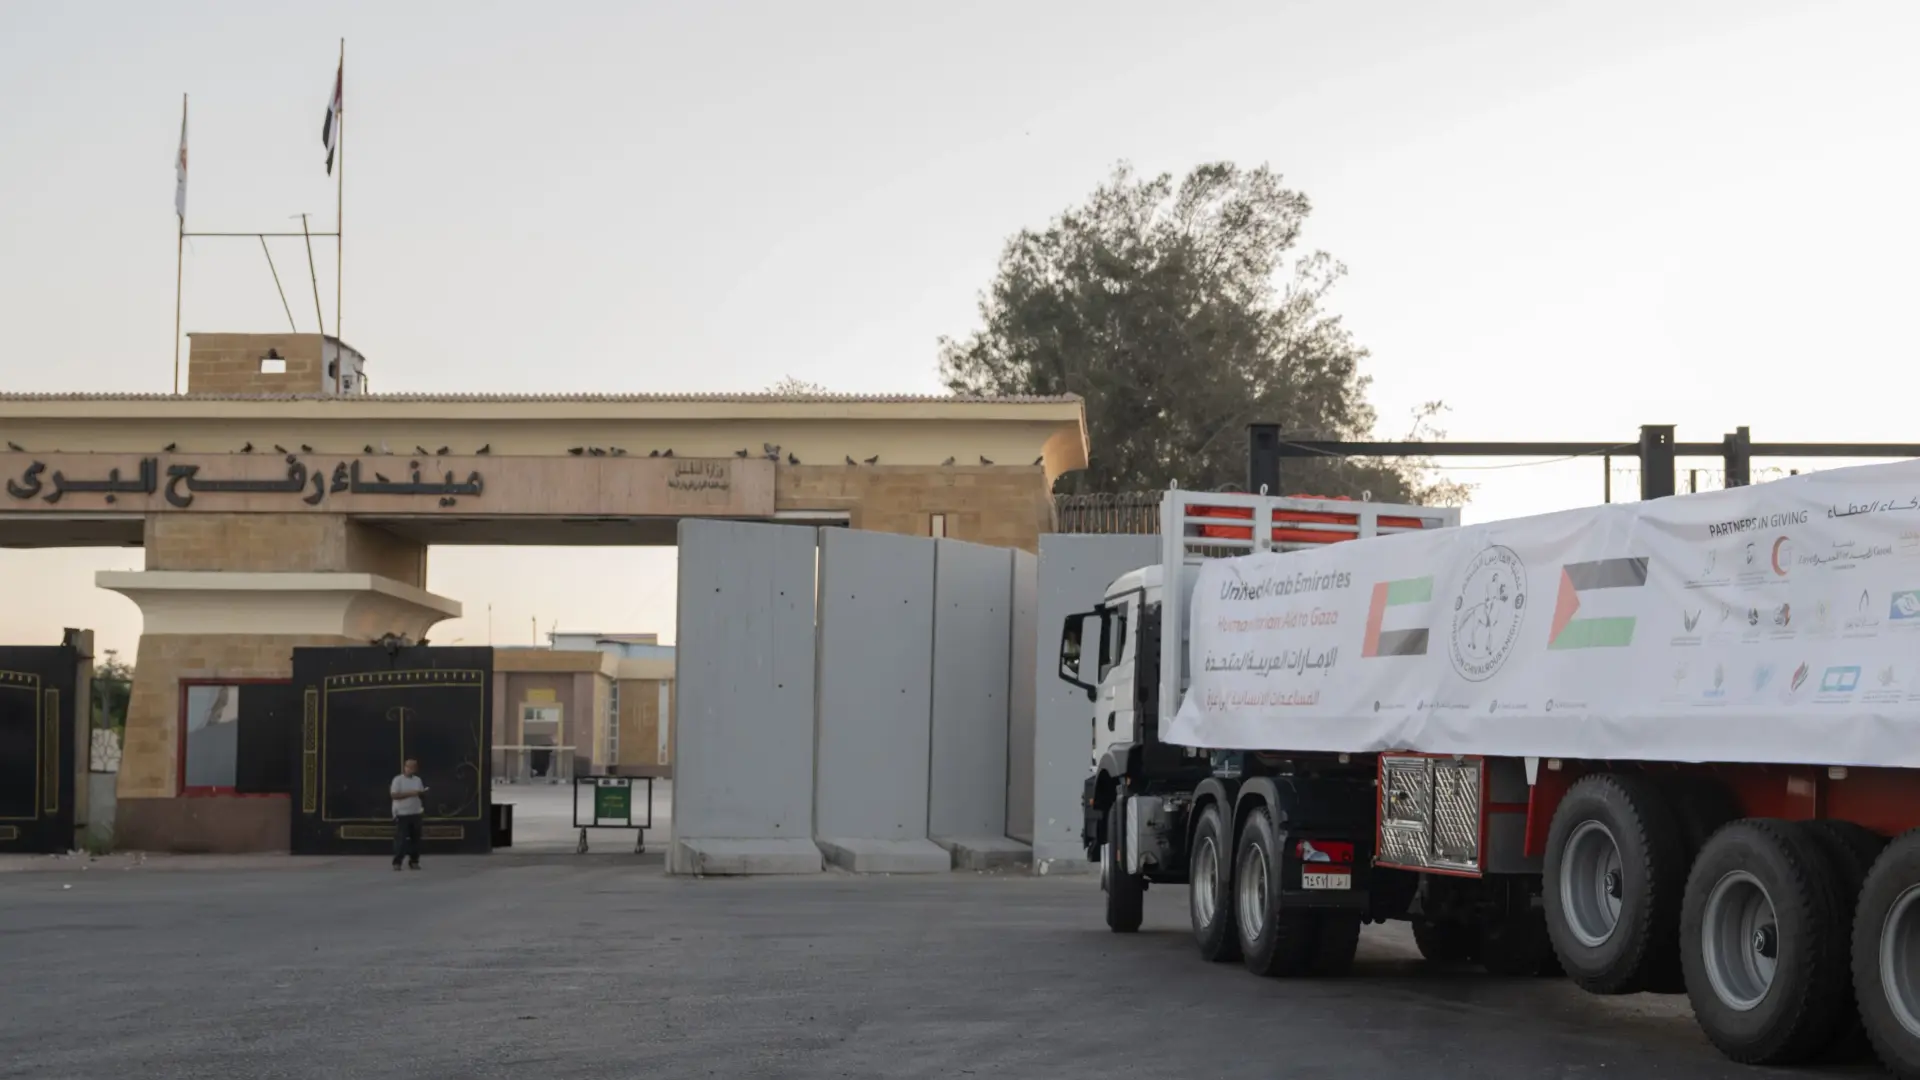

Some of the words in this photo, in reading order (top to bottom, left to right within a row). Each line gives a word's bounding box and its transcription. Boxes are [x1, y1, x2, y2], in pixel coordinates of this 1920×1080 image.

[165, 454, 325, 507] رفح
[330, 457, 485, 507] ميناء
[1709, 517, 1757, 537] PARTNERS
[1758, 515, 1768, 530] IN
[1770, 510, 1808, 528] GIVING
[1827, 500, 1880, 518] العطاء
[1220, 579, 1264, 601] United
[1264, 575, 1294, 597] Arab
[1294, 570, 1352, 594] Emirates
[1309, 606, 1340, 627] Gaza
[1205, 650, 1250, 672] المتحدة
[1247, 649, 1289, 678] العربية
[1287, 646, 1339, 677] الإمارات
